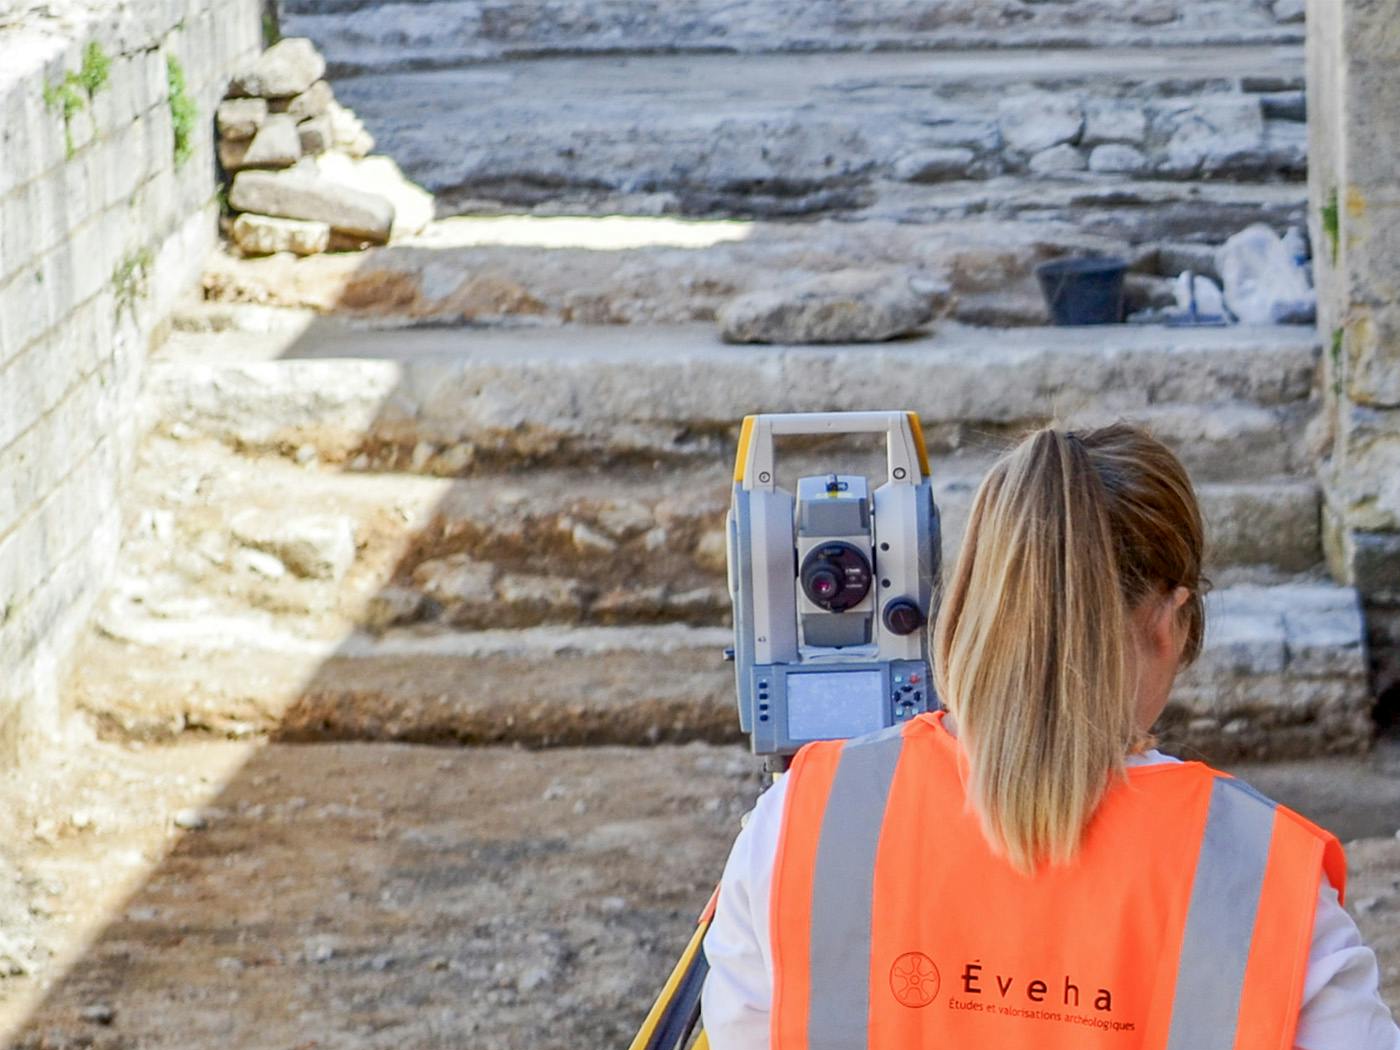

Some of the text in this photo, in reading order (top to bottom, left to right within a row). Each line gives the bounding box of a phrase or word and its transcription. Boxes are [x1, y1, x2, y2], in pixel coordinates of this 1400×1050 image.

[961, 959, 1112, 1012] Éveha
[948, 997, 1135, 1031] Études et valorisations archéologiques
